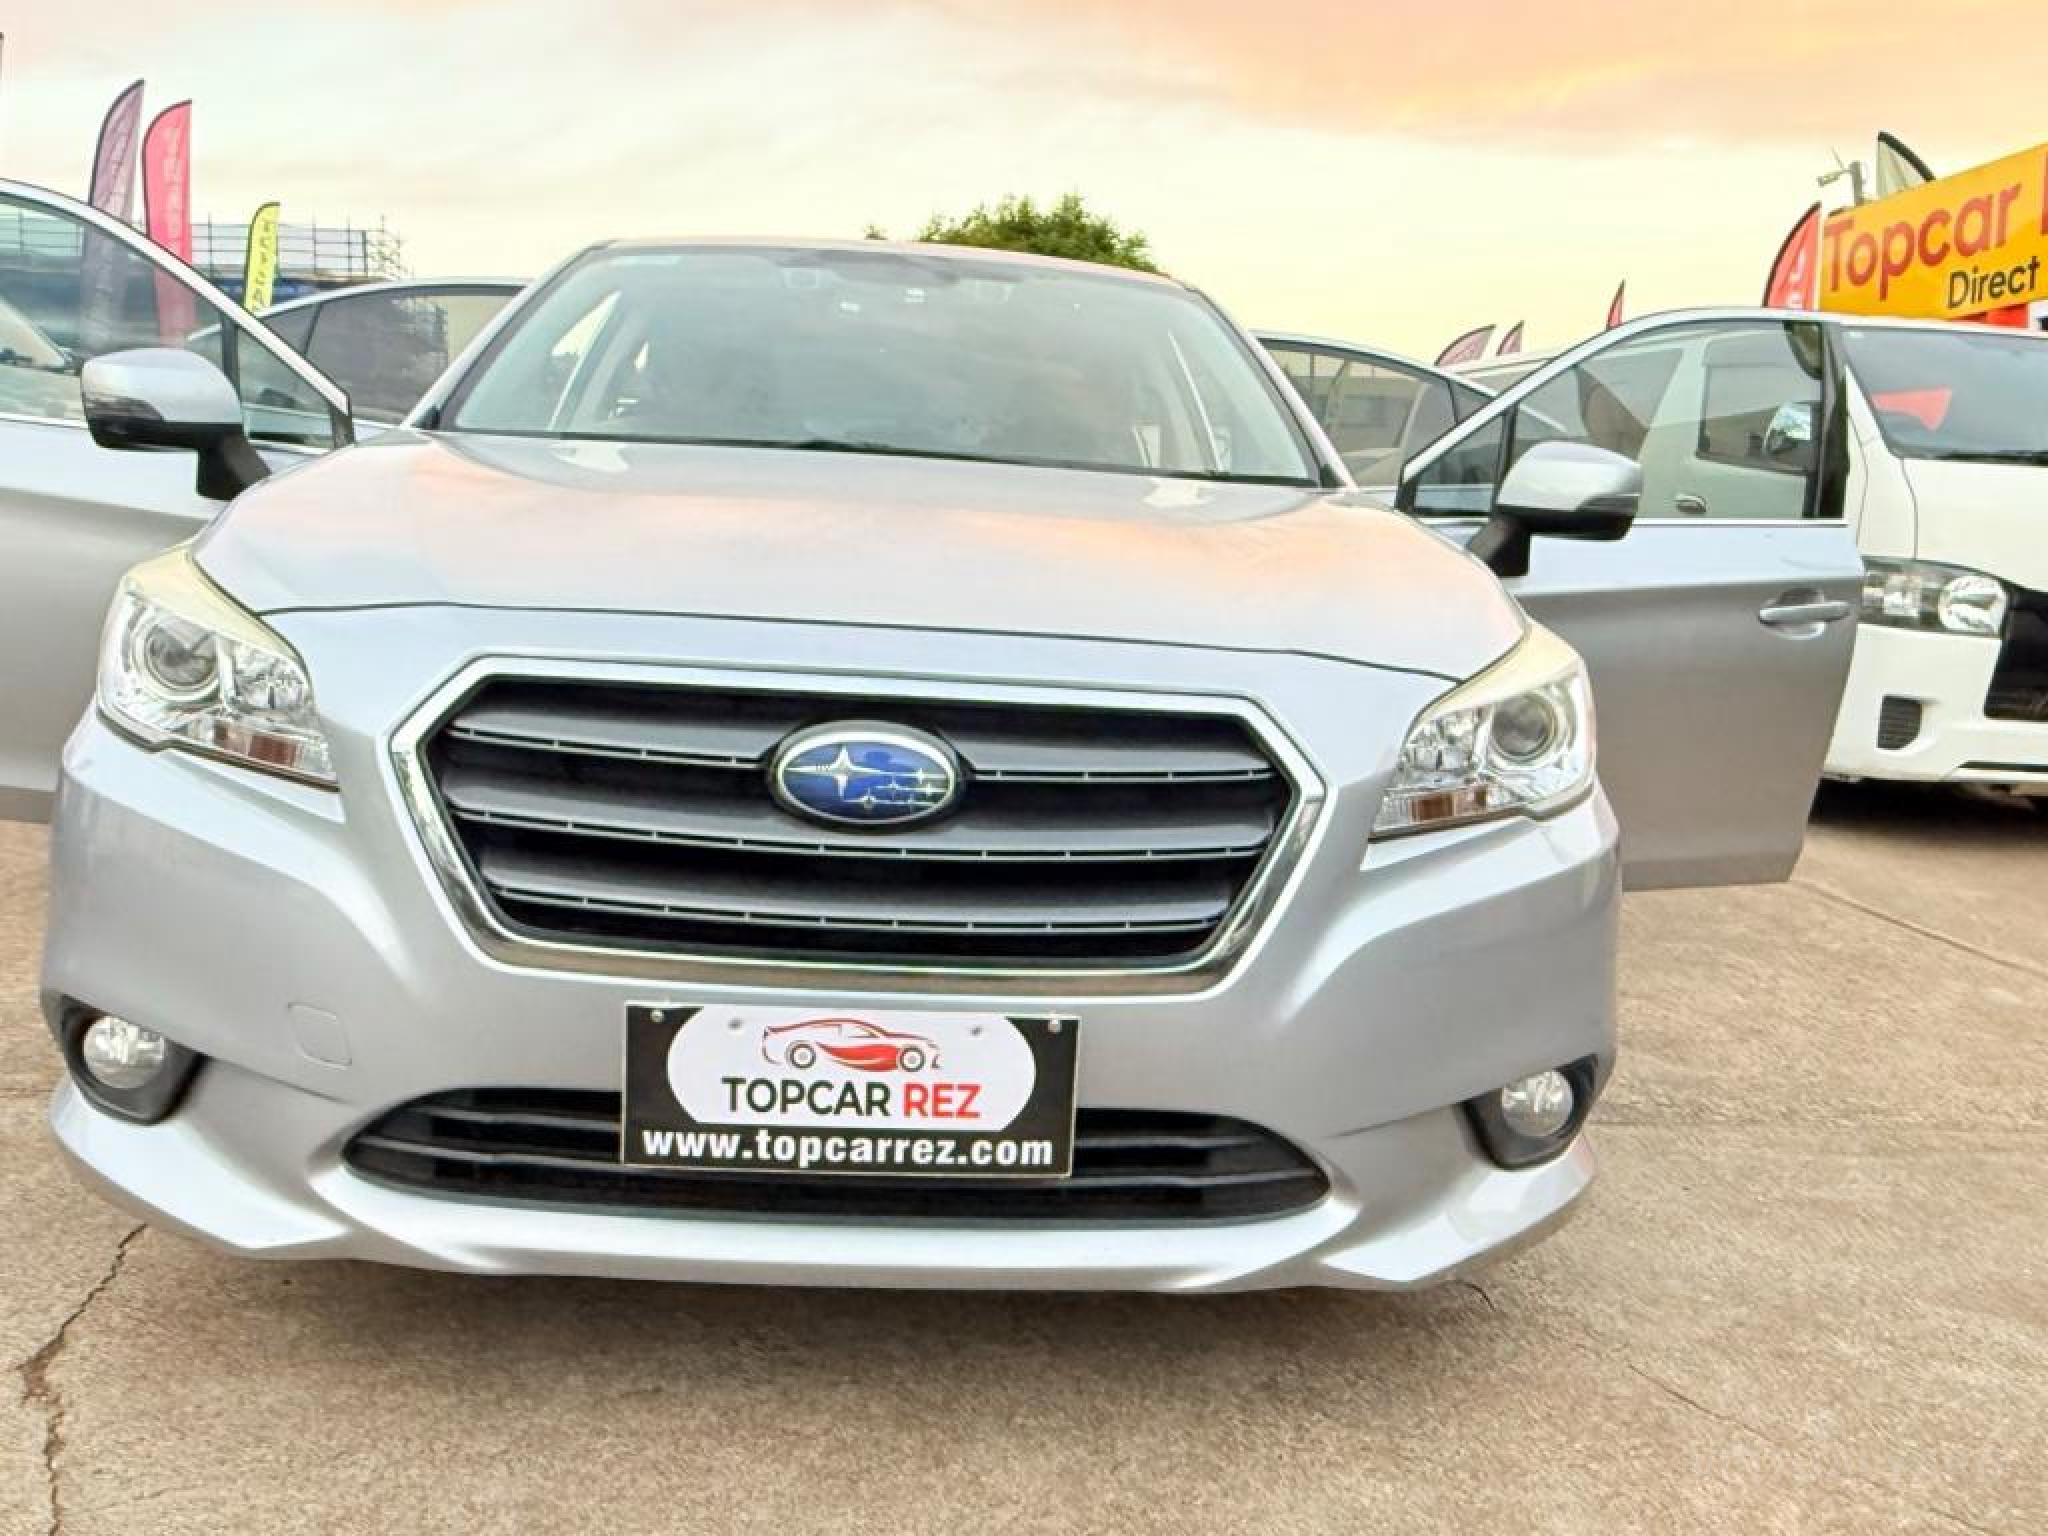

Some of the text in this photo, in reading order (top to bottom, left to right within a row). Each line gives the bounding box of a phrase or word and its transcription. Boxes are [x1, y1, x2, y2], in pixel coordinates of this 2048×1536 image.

[1823, 184, 2022, 302] Topcar
[1947, 255, 2041, 310] Direct
[721, 1076, 981, 1119] TOPCAR REZ
[641, 1127, 1054, 1168] www.topcarrez.com
